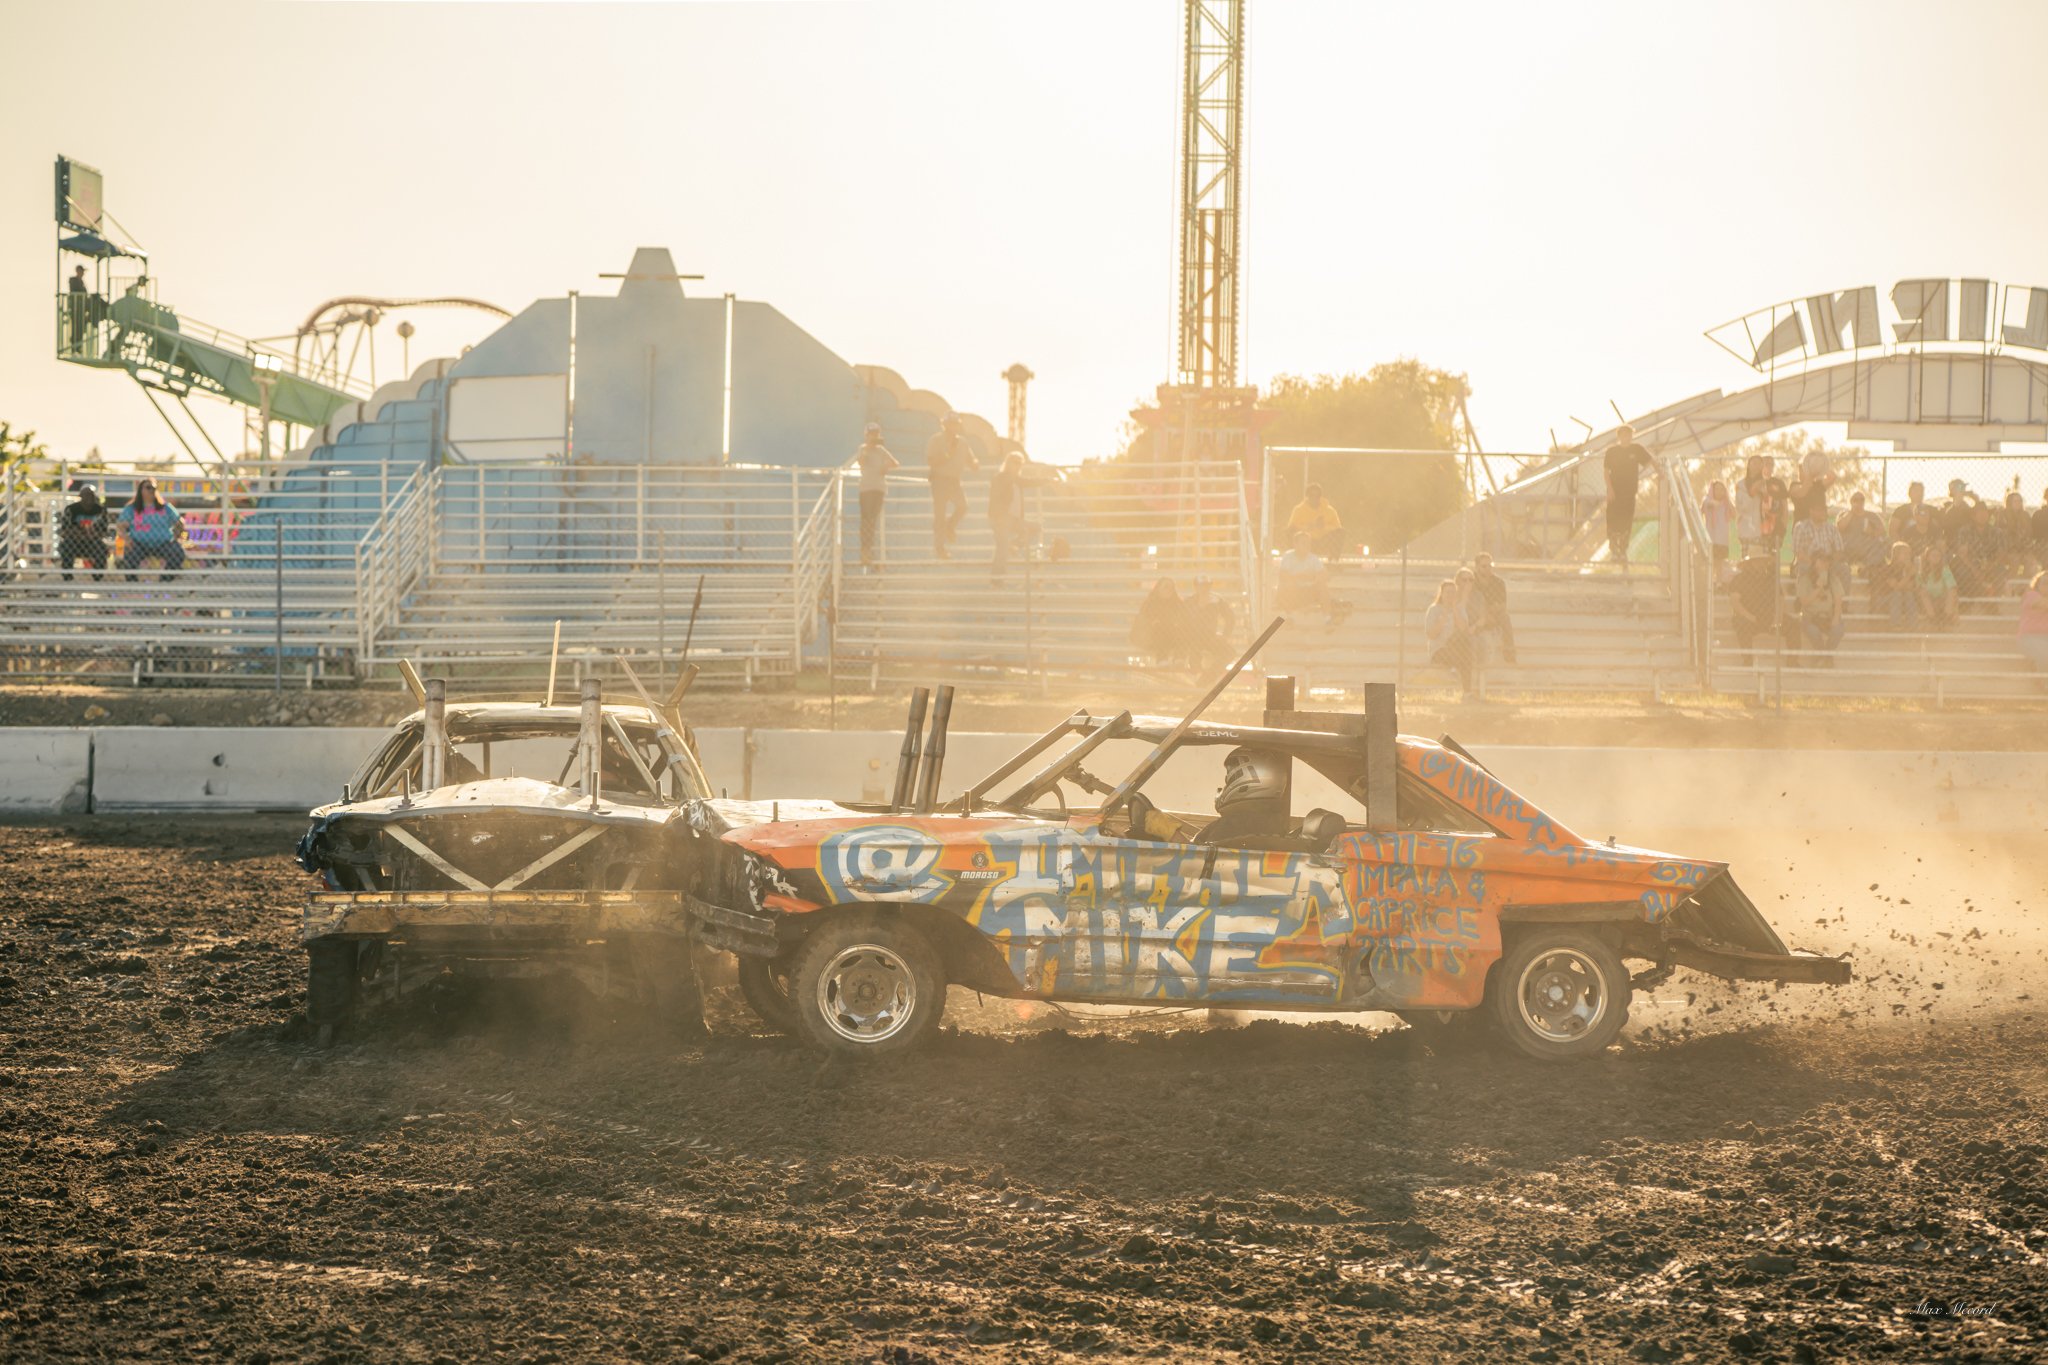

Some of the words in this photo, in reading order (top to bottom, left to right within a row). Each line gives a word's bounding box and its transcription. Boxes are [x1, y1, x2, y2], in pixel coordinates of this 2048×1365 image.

[960, 871, 1000, 879] MOROSO
[1356, 864, 1462, 901] IMPALA
[1355, 897, 1481, 940] CAPRICE
[1022, 898, 1336, 997] MIKE
[1348, 935, 1468, 977] PARTS
